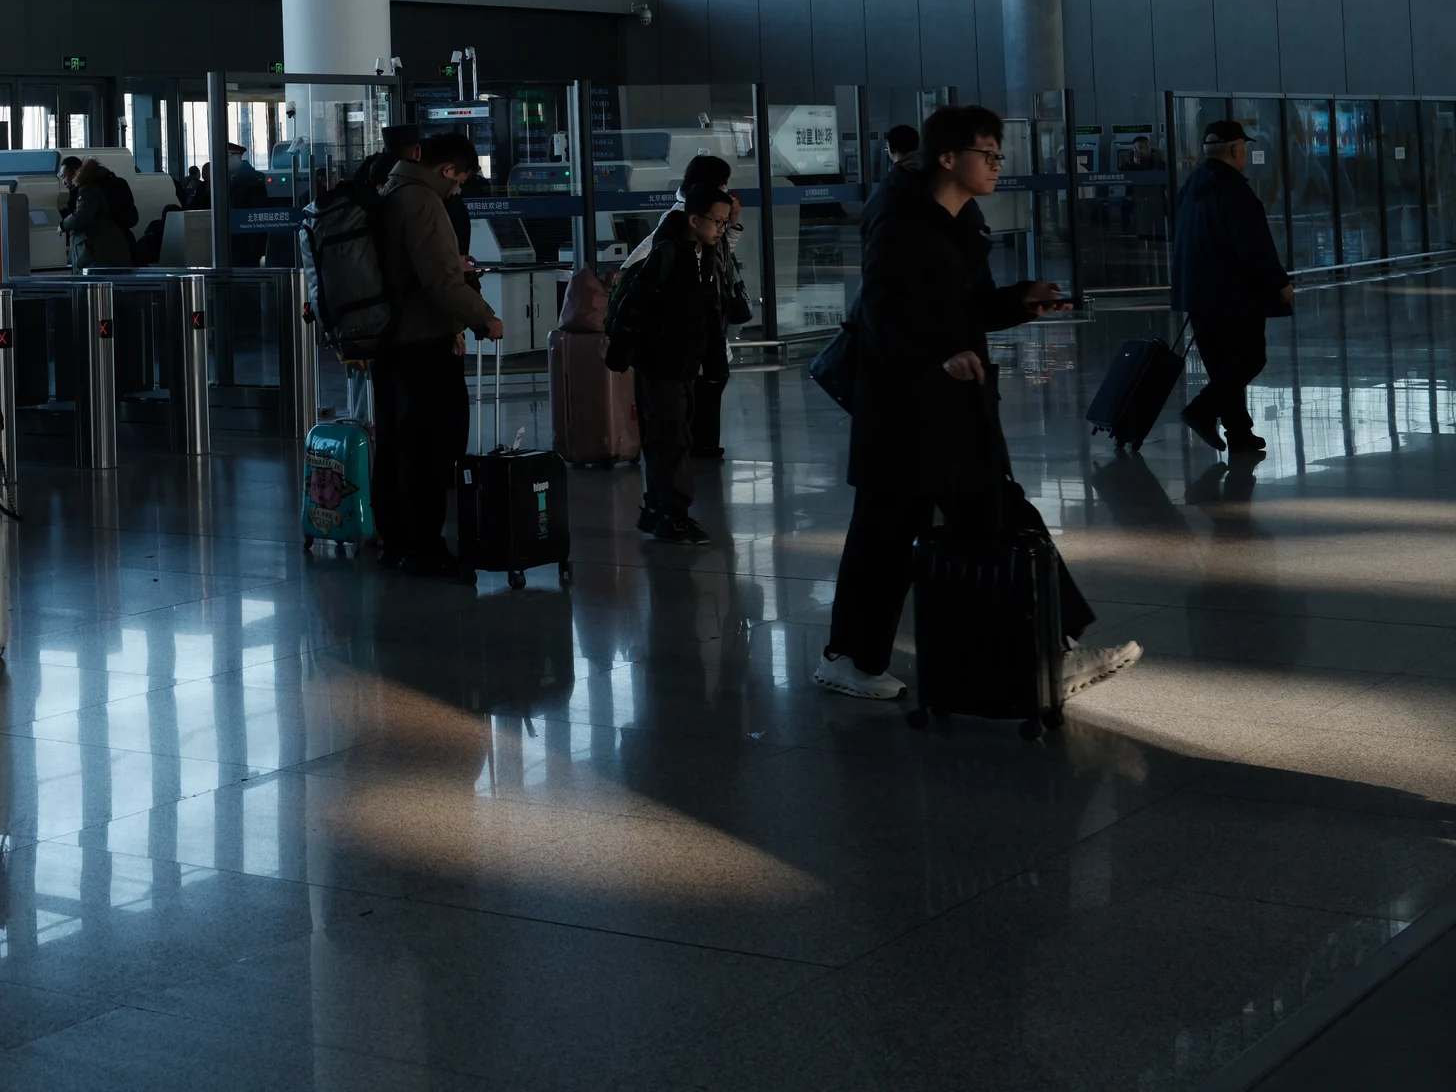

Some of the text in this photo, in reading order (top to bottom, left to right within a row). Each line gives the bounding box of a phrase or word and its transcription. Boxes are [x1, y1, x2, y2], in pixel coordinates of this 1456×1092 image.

[464, 201, 510, 210] 朝阳站欢迎您
[247, 211, 290, 222] 北京朝阳站欢迎您
